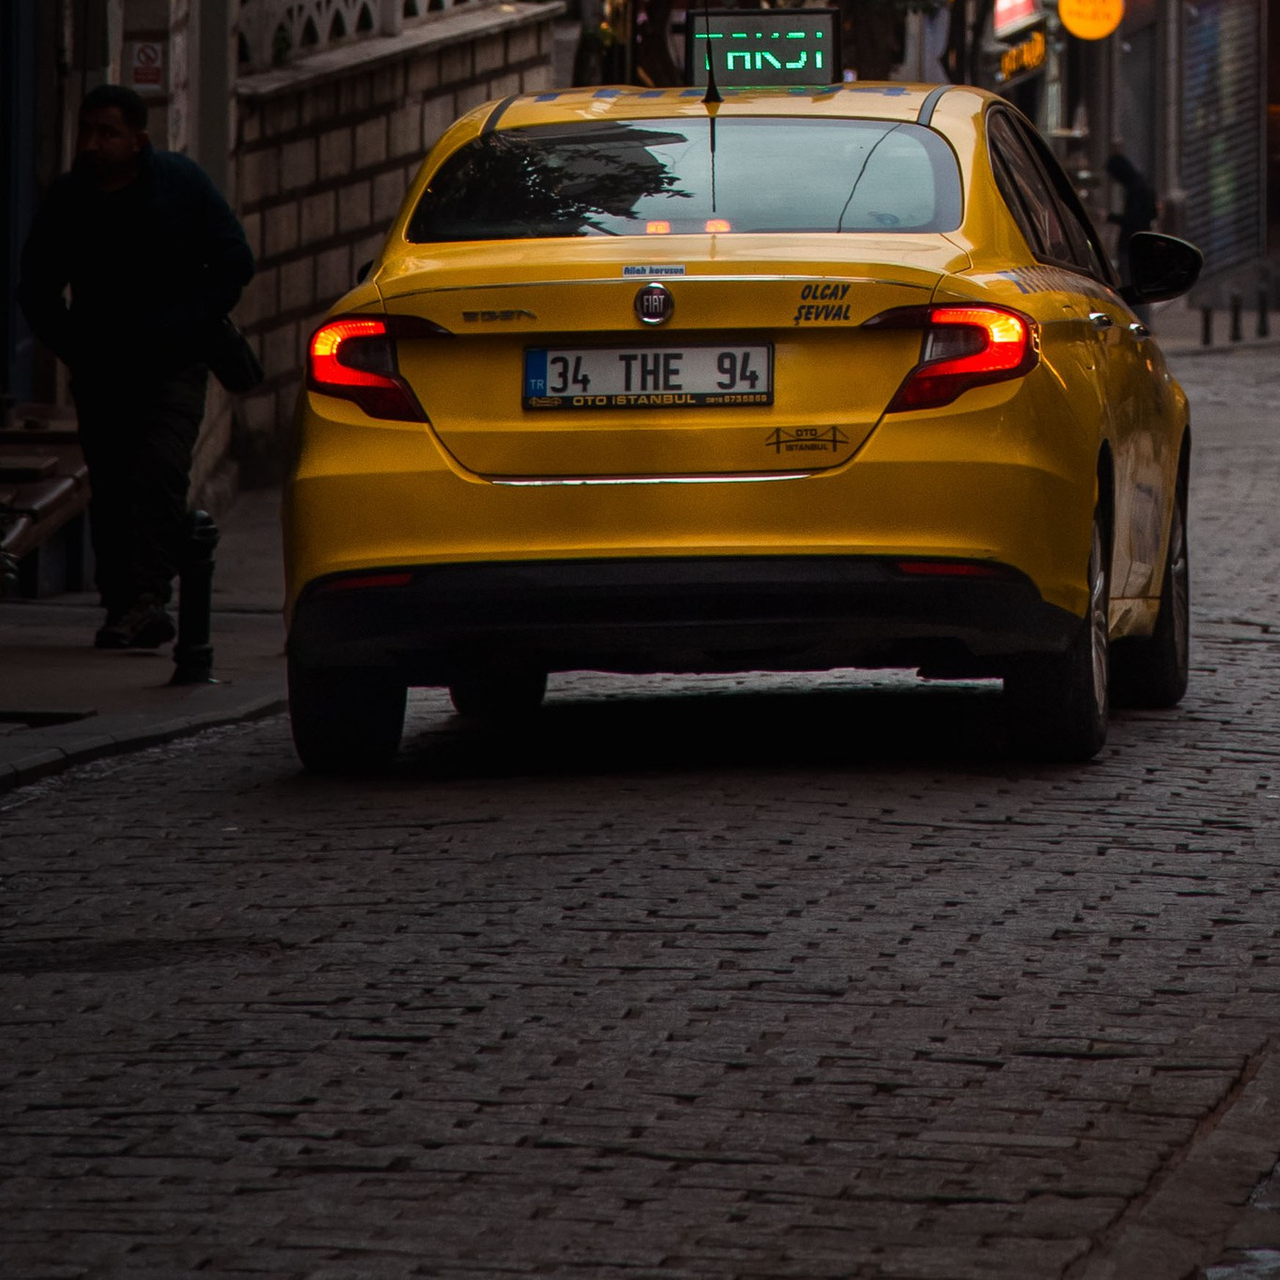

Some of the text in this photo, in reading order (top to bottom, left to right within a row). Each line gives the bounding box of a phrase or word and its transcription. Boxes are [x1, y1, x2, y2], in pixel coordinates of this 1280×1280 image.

[624, 266, 646, 275] Allah
[801, 284, 851, 300] OLCAY
[643, 295, 665, 313] FIAT
[550, 352, 759, 393] 34 THE 94
[529, 379, 545, 390] TR
[572, 396, 607, 406] OTO
[795, 428, 818, 437] OTO
